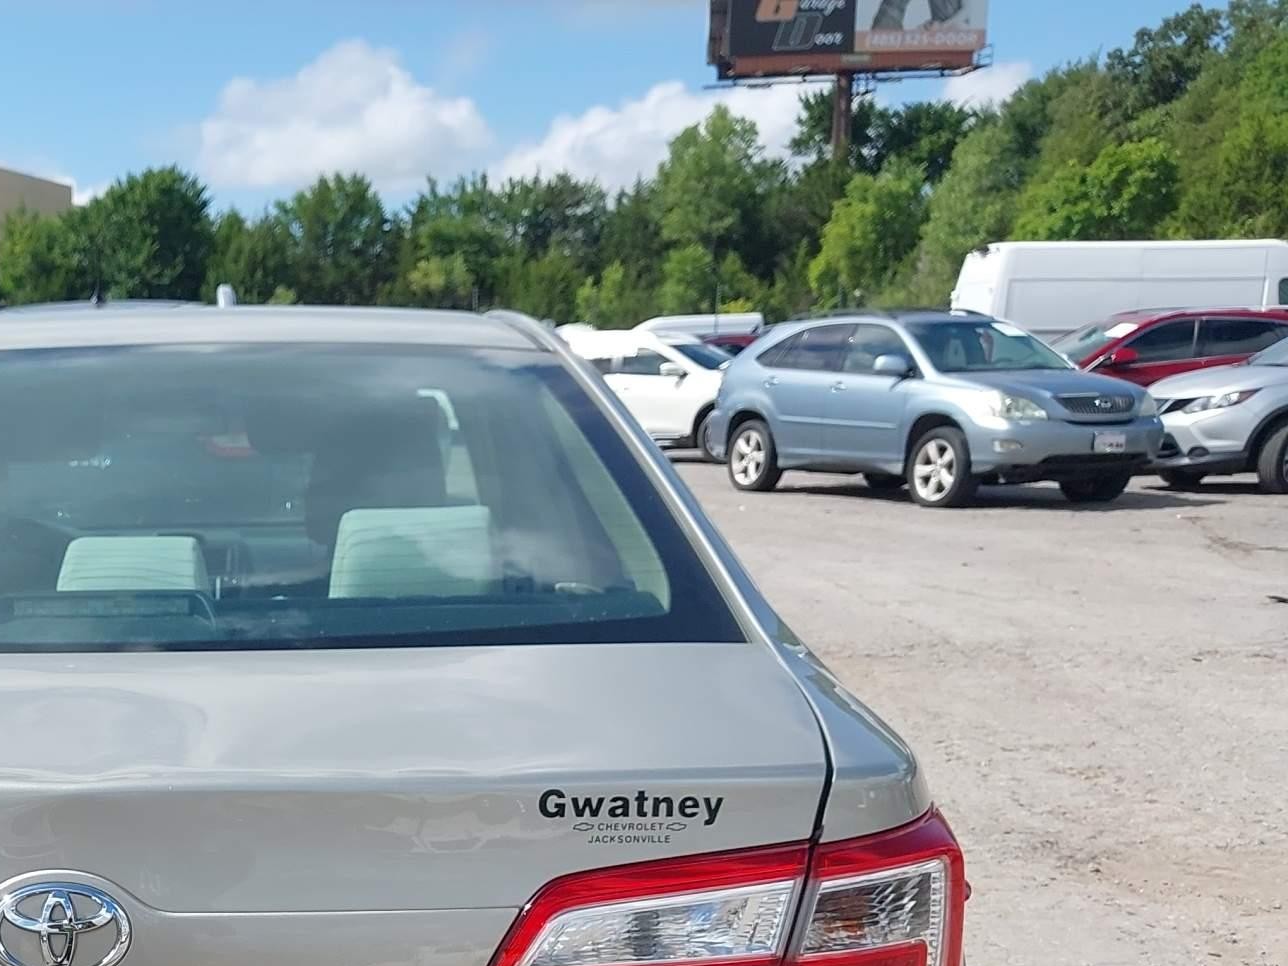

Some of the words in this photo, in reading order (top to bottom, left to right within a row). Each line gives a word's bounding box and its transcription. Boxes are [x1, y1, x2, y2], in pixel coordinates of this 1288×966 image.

[538, 788, 724, 826] Gwatney
[597, 822, 664, 832] CHEVROLET
[587, 834, 671, 844] JACKSONVILLE
